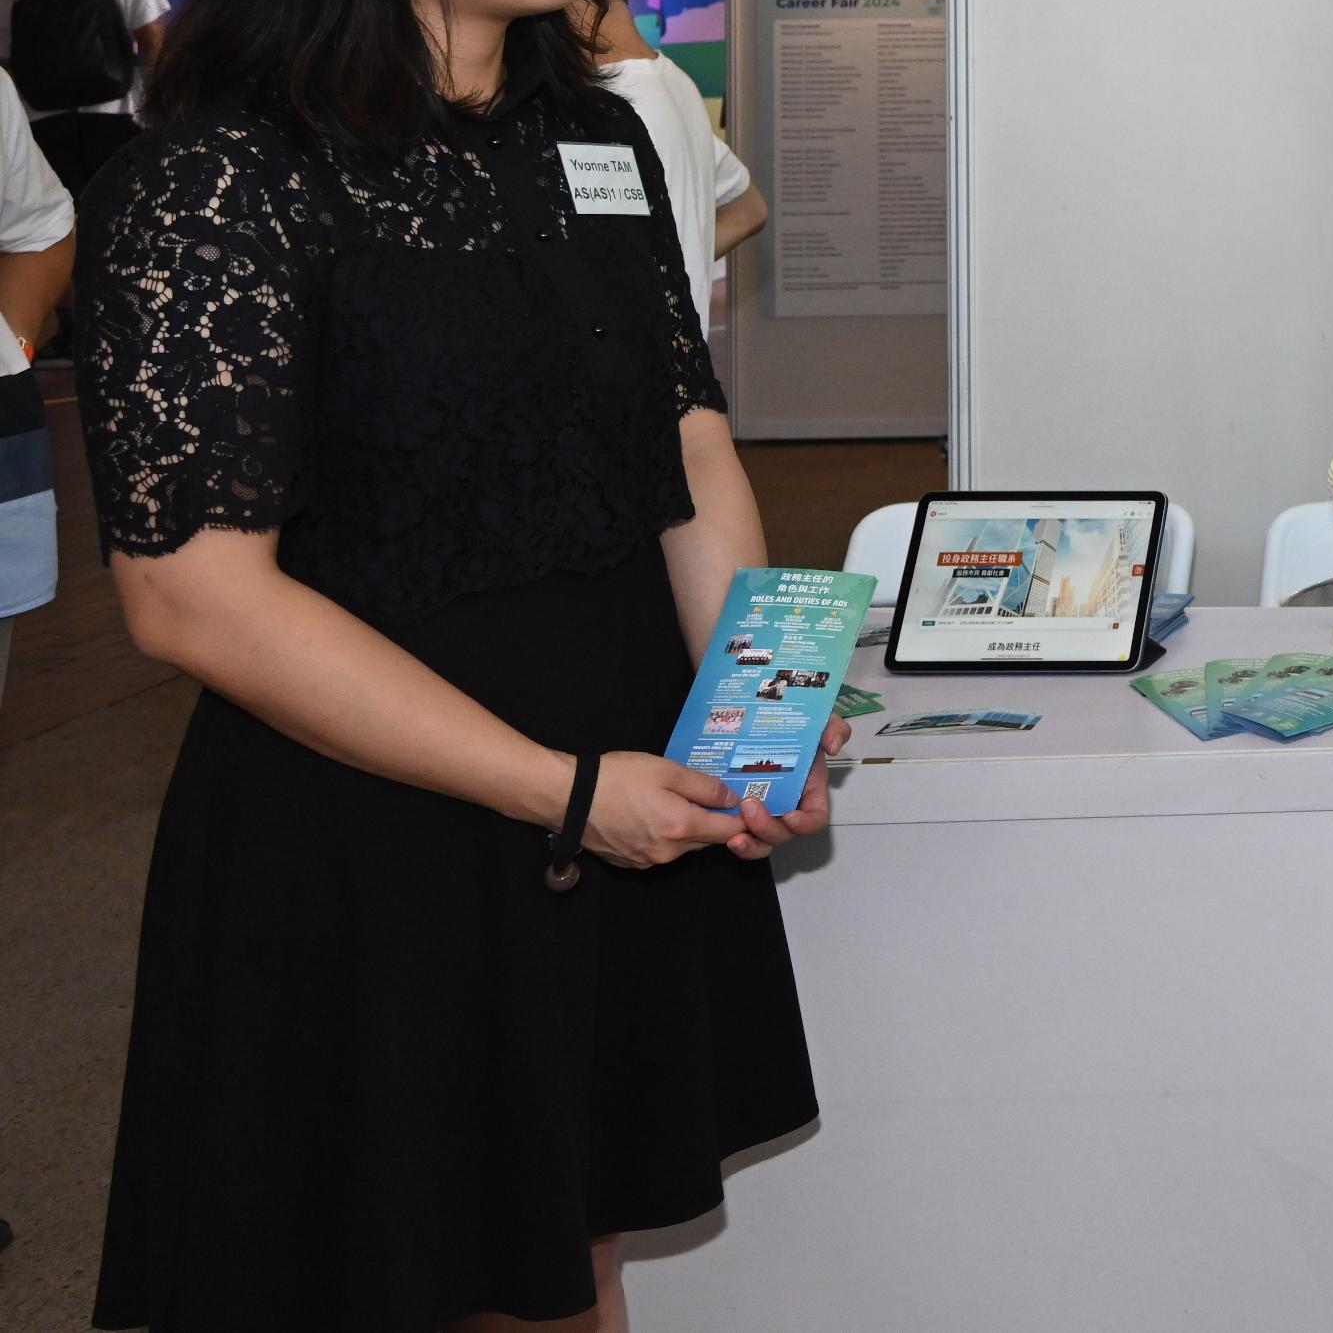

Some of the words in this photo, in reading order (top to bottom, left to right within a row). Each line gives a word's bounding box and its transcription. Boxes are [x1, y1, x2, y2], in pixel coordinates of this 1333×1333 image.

[570, 159, 609, 171] Yvonne
[610, 161, 632, 172] TAM
[624, 189, 644, 200] CSB
